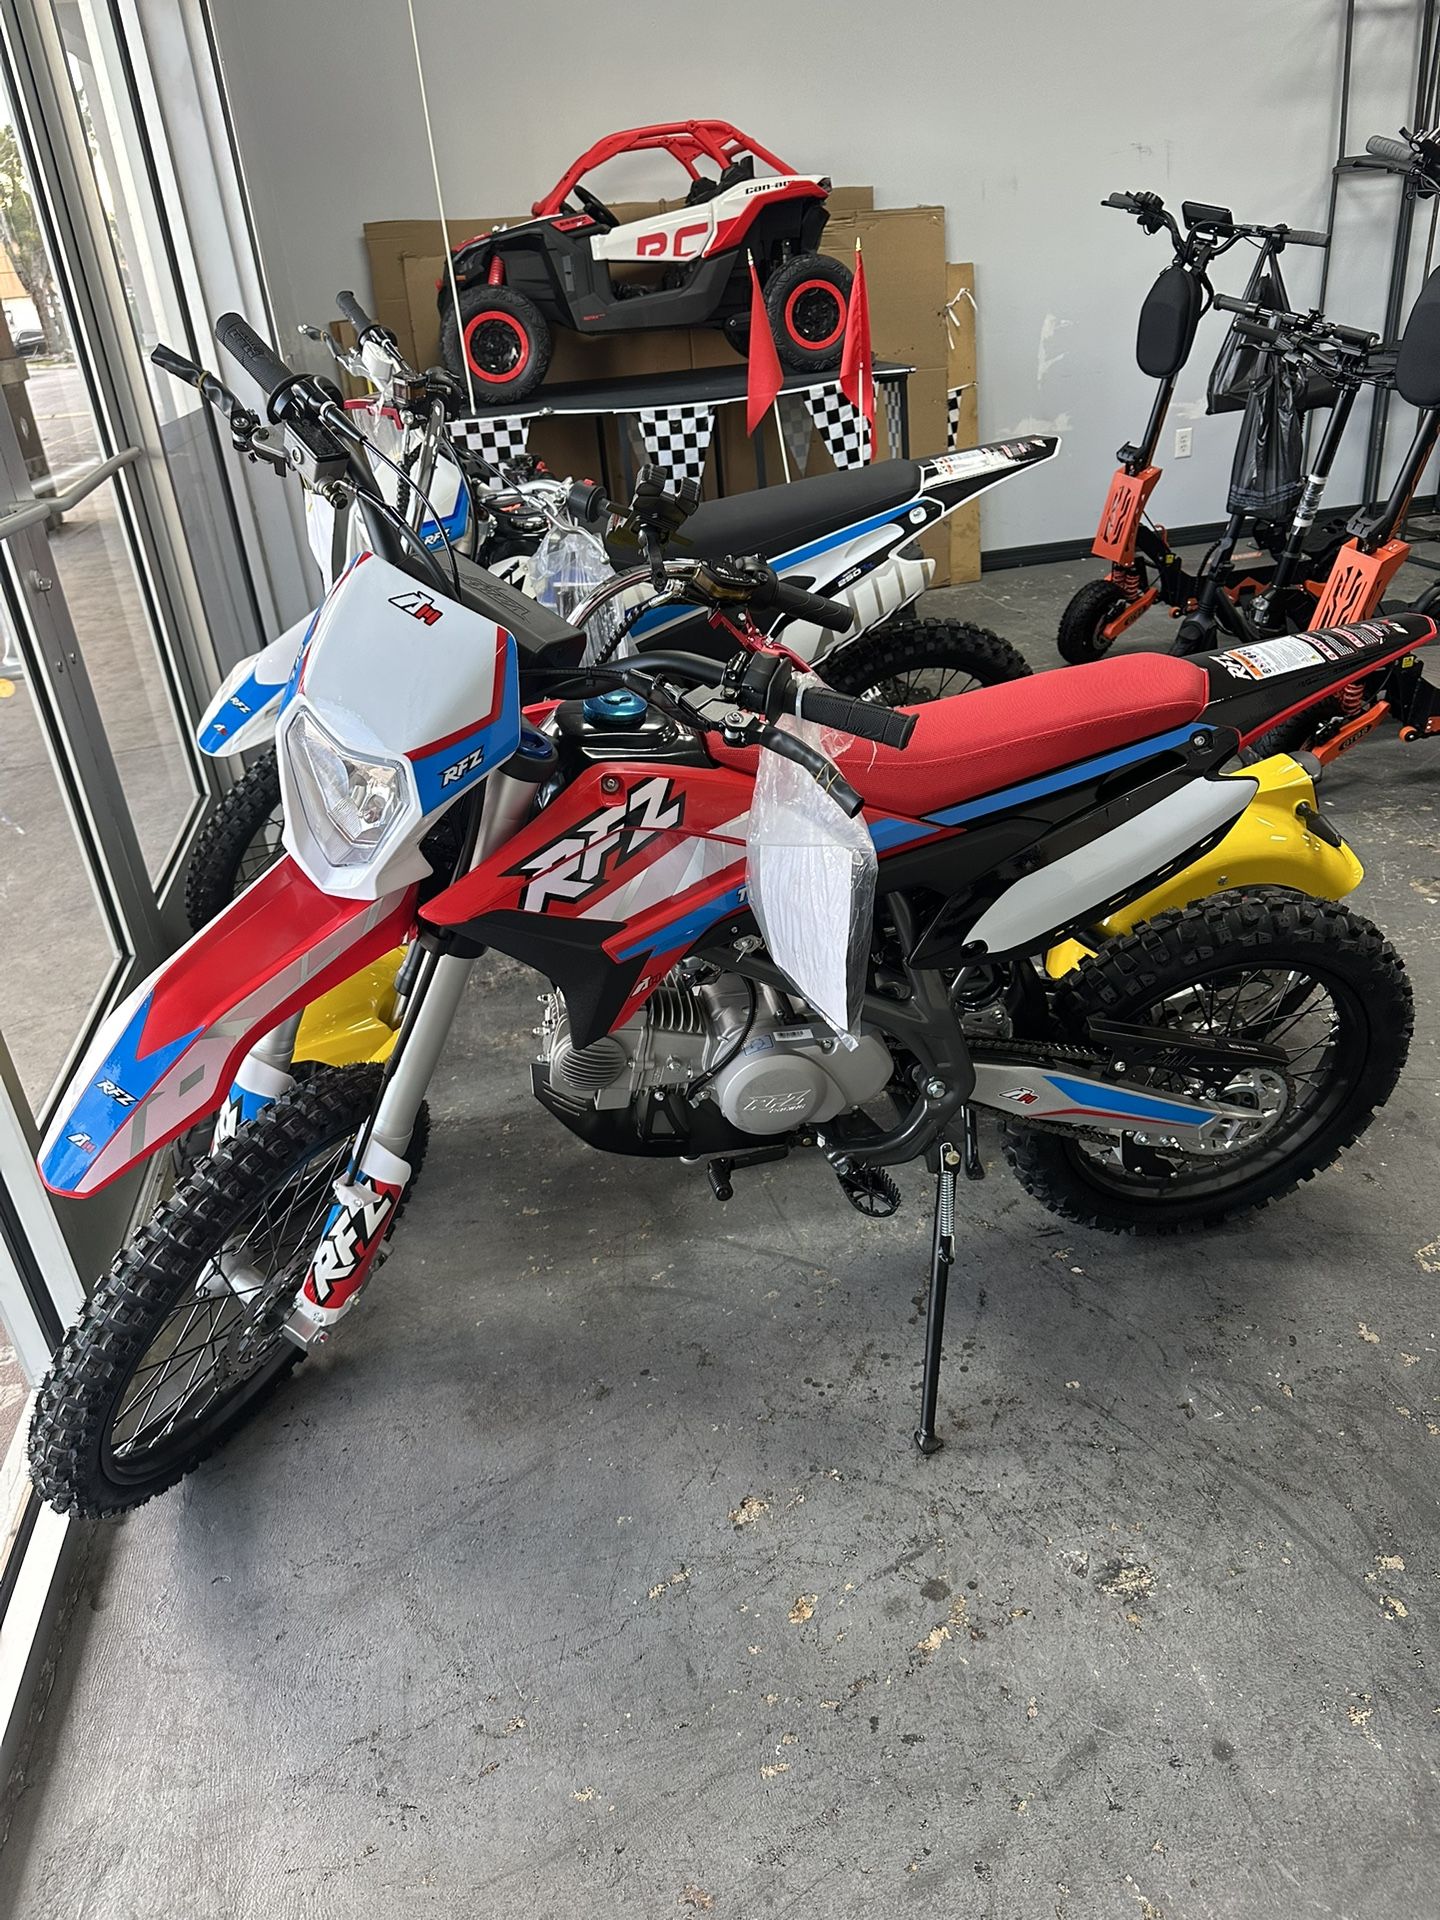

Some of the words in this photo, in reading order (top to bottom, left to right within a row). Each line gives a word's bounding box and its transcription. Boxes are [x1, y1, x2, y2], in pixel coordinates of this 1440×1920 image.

[440, 746, 484, 787] RFZ
[517, 777, 682, 913] RFZ
[95, 1079, 138, 1107] RFZ
[314, 1178, 392, 1302] RFZ
